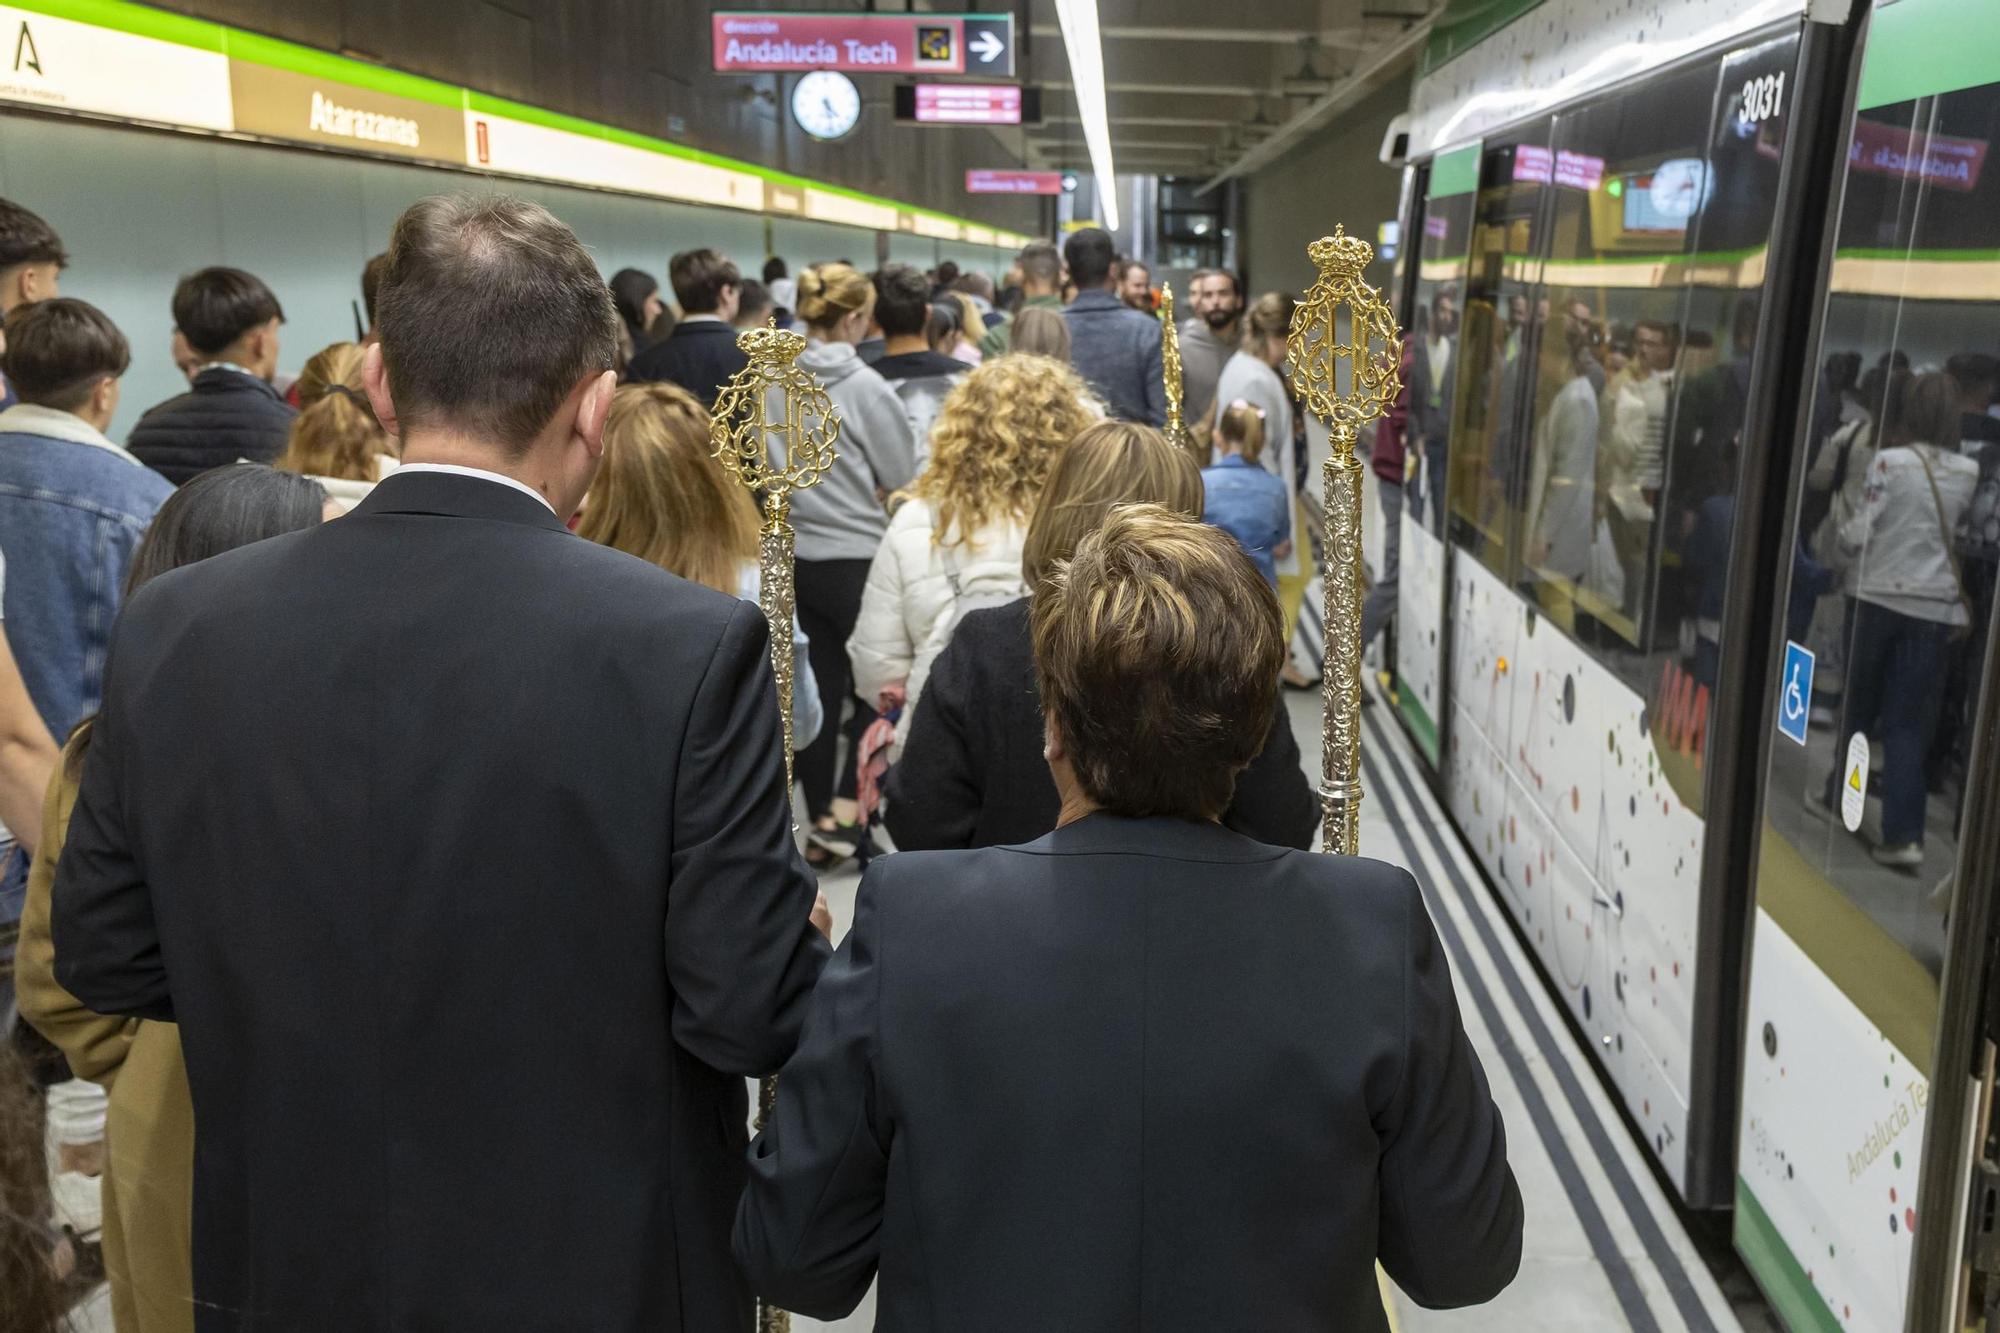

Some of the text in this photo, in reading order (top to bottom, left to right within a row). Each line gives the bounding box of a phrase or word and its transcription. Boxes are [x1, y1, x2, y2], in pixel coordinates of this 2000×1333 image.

[725, 38, 898, 65] Andalucía Tech
[1738, 70, 1786, 124] 3031
[310, 90, 421, 149] Atarazanas
[1905, 1080, 1928, 1115] Te
